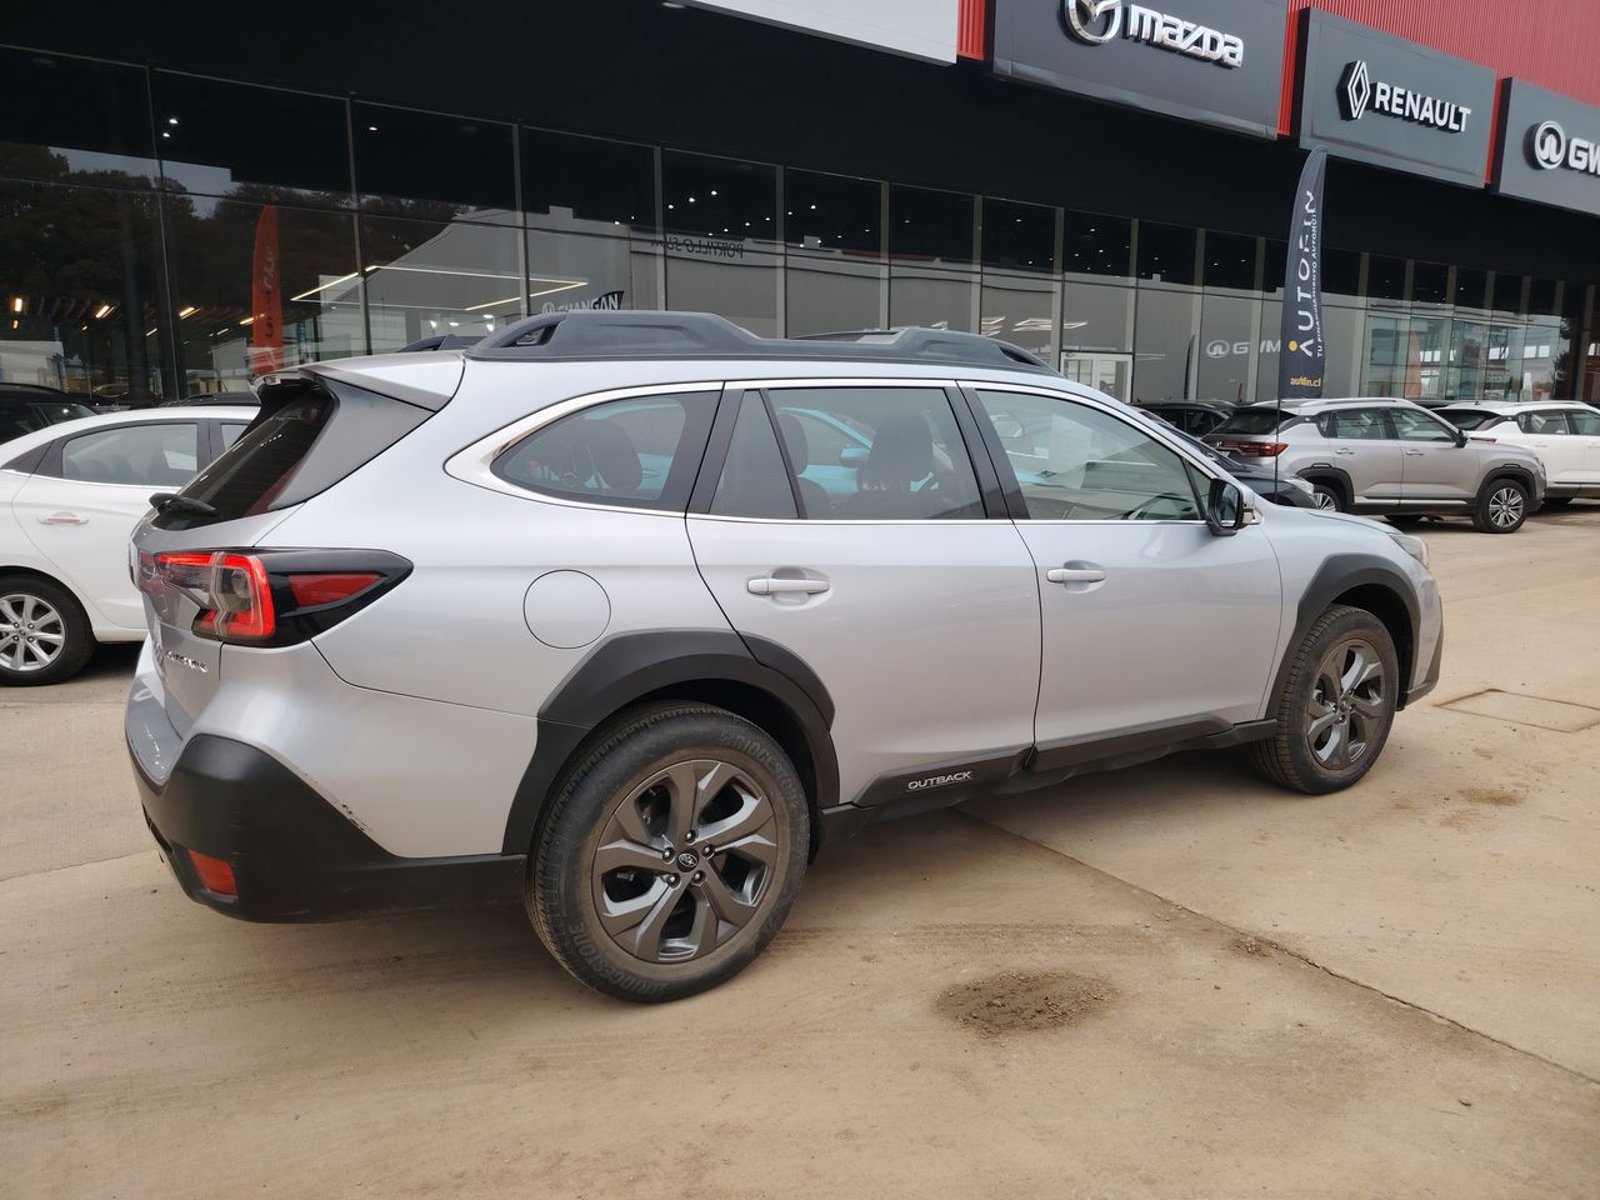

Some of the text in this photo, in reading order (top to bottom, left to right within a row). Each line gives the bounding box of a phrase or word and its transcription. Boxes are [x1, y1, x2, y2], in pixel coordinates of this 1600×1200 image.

[1127, 4, 1244, 68] mazda
[1375, 81, 1471, 132] RENAULT
[1297, 190, 1315, 358] AUTOFIN
[908, 771, 973, 790] OUTBACK
